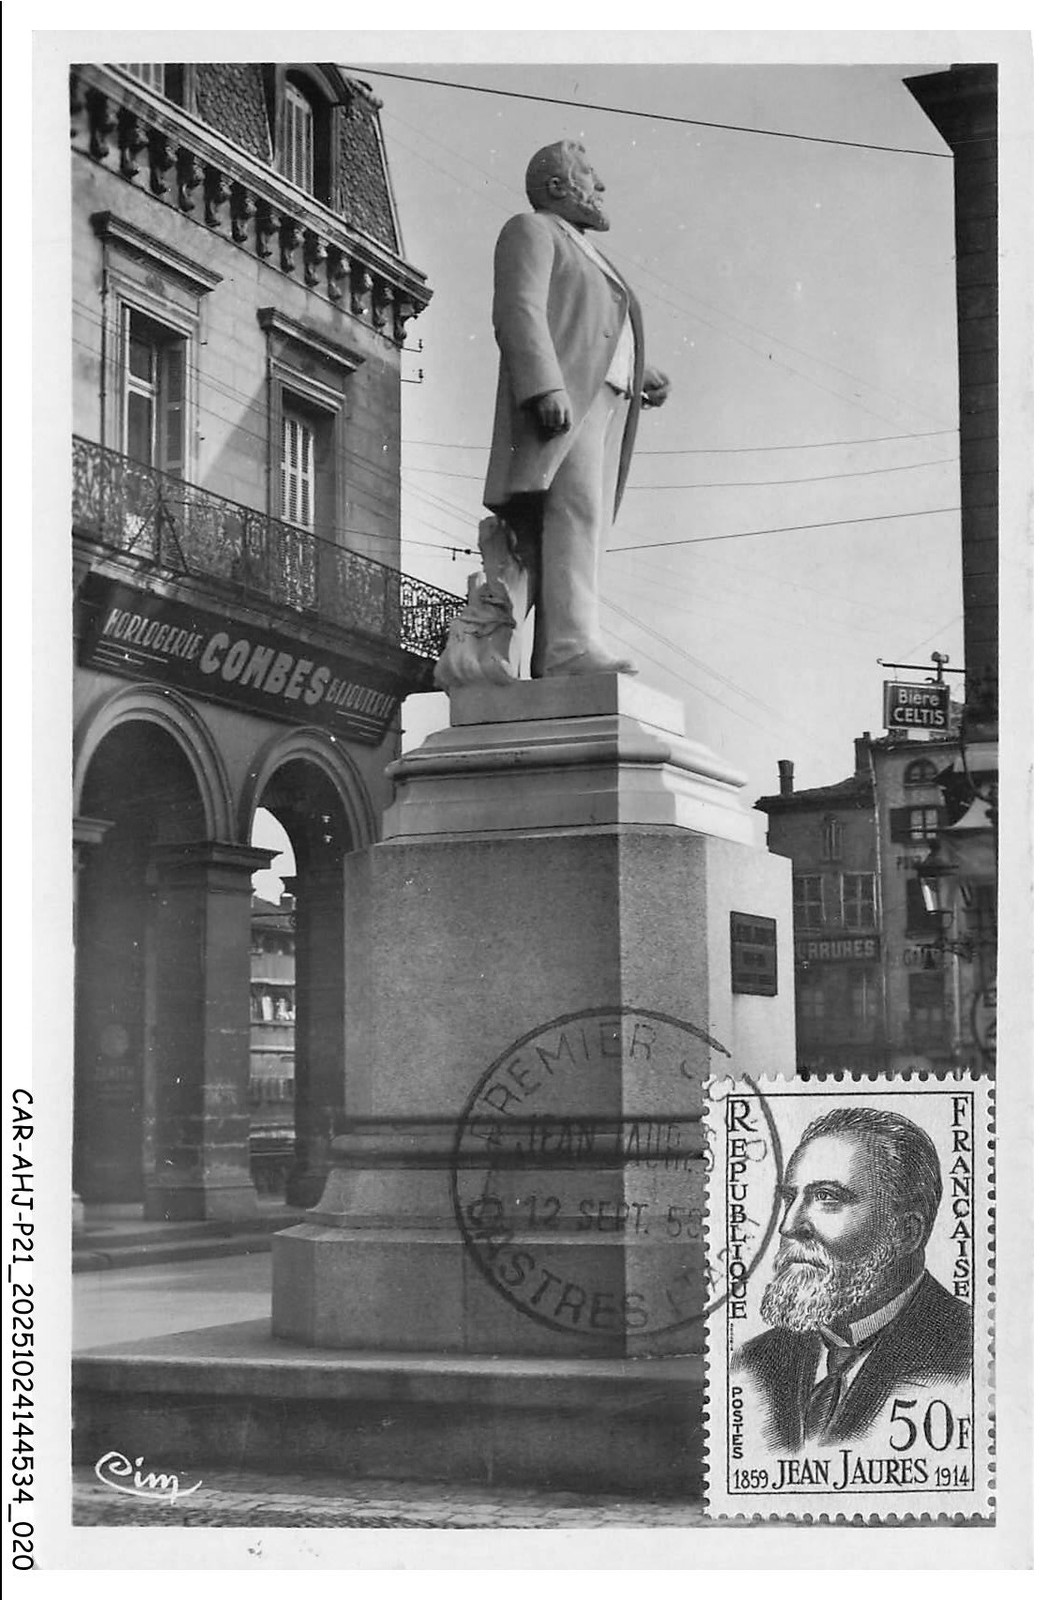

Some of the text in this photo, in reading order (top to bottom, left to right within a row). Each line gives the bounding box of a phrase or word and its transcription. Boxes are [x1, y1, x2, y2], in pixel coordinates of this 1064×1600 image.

[102, 608, 204, 660] HORLOGERIE
[200, 632, 332, 706] COMBES
[893, 707, 945, 725] CELTIS
[523, 1196, 562, 1227] 12
[579, 1200, 650, 1234] SEPT.
[950, 1096, 971, 1298] FRANÇAISE
[731, 1386, 744, 1460] POSTES
[733, 1449, 971, 1491] 1859 JEAN JAURES 1914
